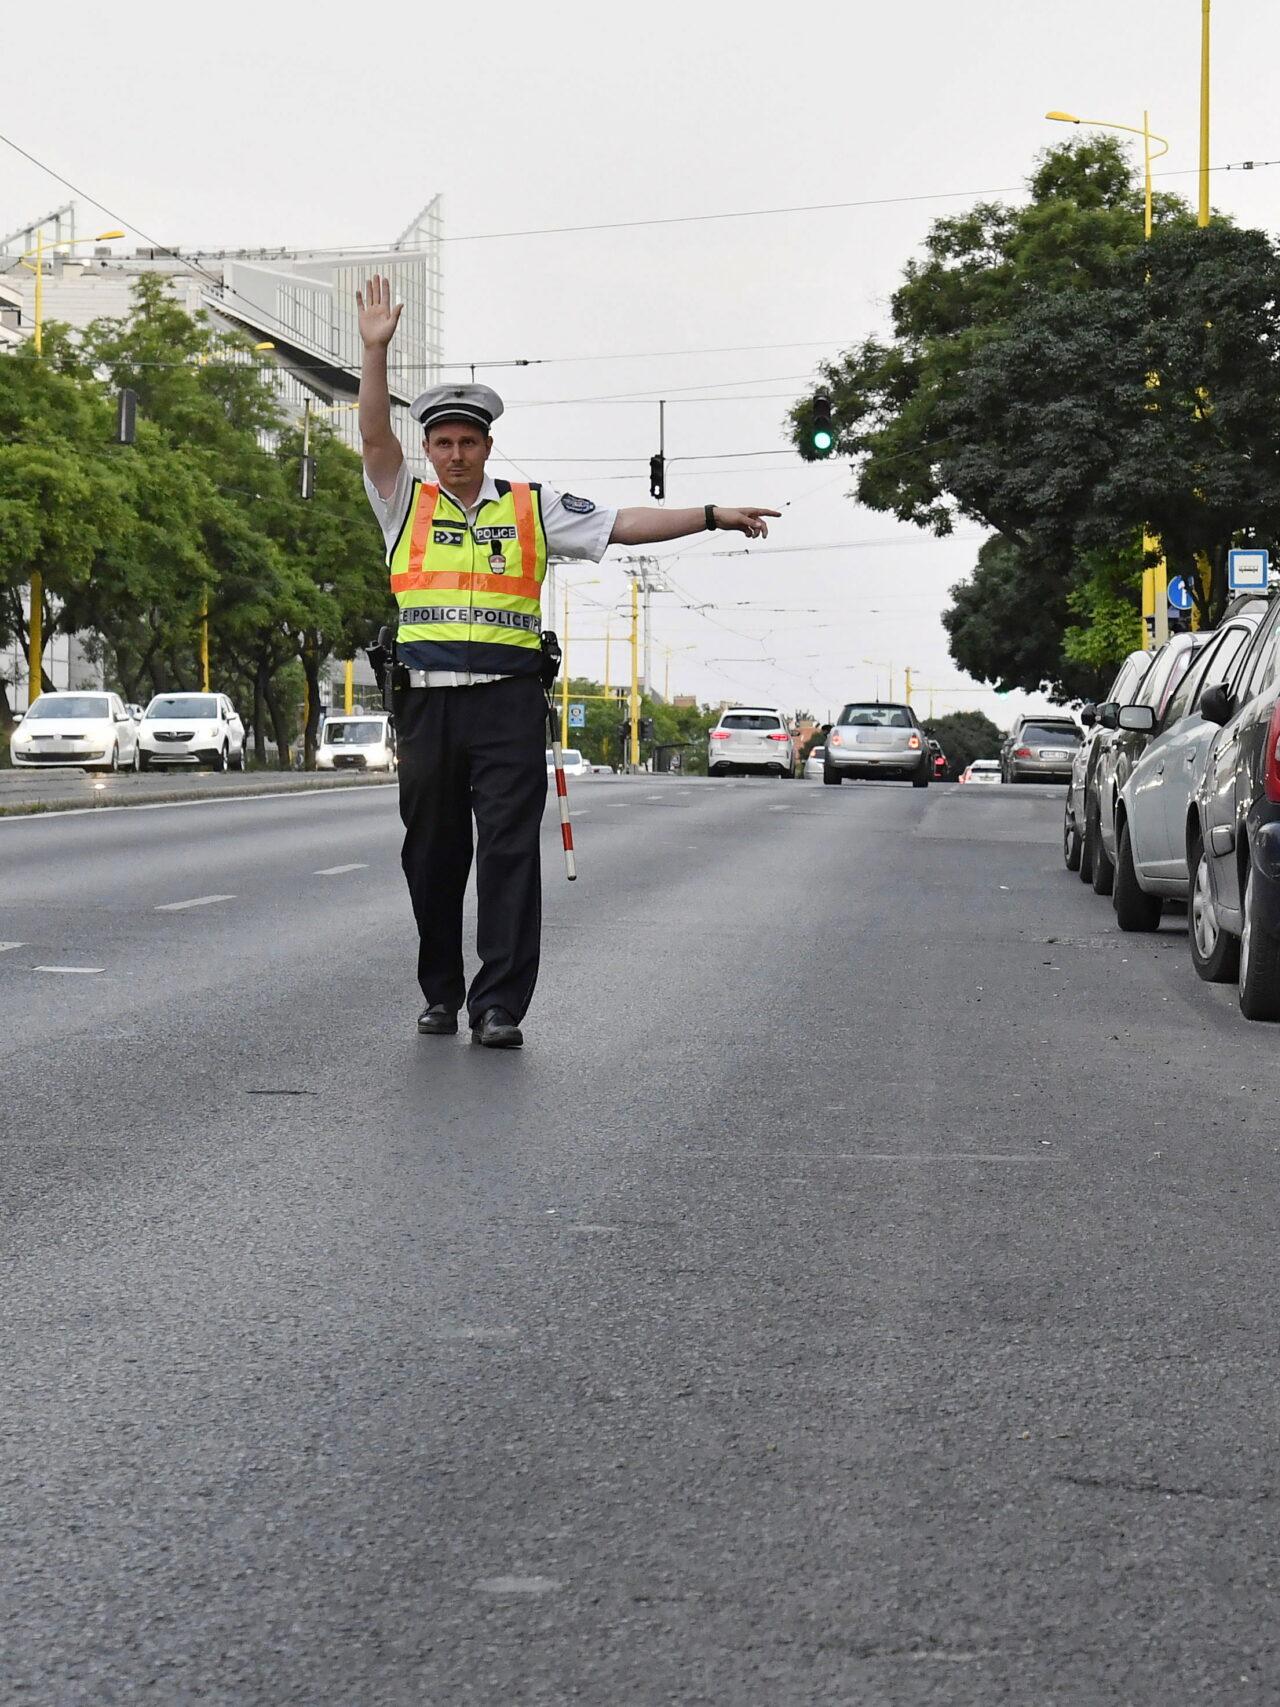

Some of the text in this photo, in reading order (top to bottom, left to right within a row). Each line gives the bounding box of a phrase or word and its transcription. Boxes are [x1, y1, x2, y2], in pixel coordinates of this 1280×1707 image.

[476, 528, 516, 540] POLICE
[413, 608, 468, 622] POLICE
[474, 610, 530, 627] POLICE
